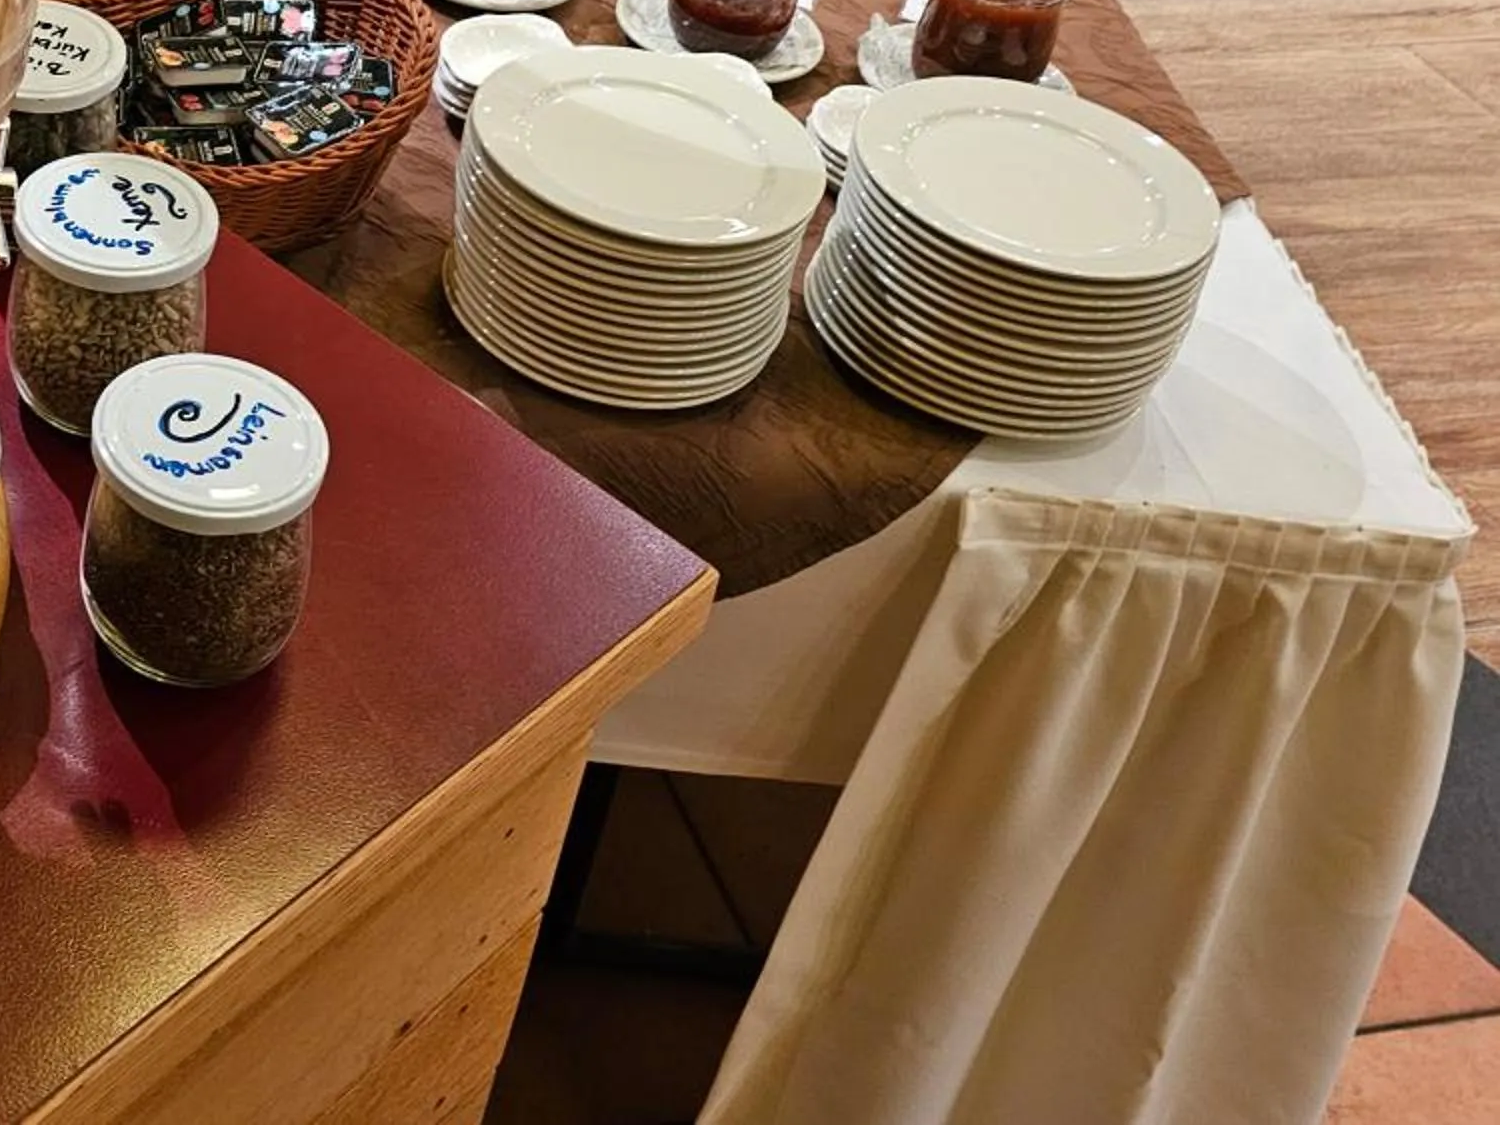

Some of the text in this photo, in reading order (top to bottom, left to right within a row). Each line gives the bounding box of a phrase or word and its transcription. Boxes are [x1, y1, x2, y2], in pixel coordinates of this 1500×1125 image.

[34, 20, 68, 39] Ker
[44, 168, 155, 256] Sonnenblumen
[143, 402, 286, 478] Leinsamen
